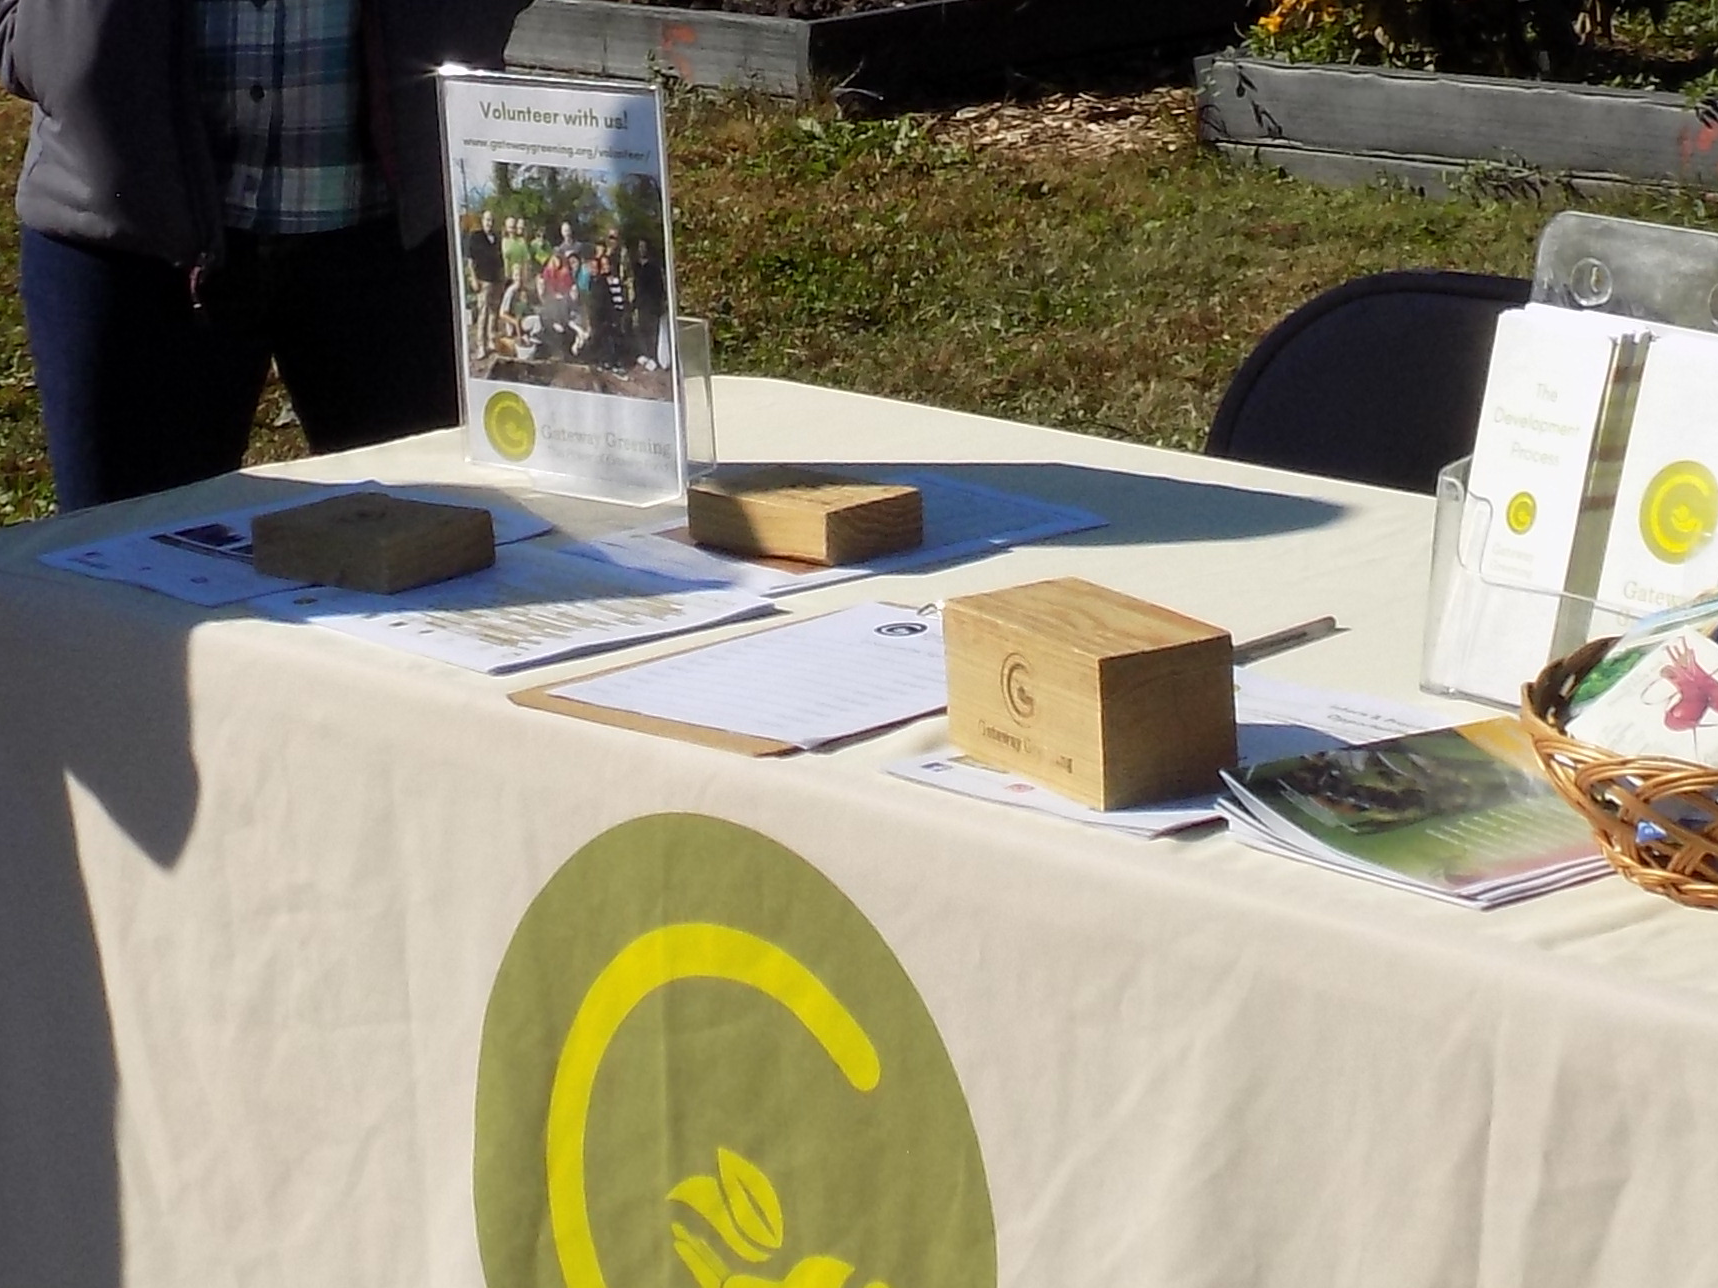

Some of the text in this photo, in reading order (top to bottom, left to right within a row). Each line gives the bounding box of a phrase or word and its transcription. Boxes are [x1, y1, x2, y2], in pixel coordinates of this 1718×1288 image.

[479, 101, 628, 130] Volunteer with us!
[463, 137, 652, 162] www.gatewaygreening.org/volunteer/
[1535, 383, 1558, 403] The
[1493, 406, 1581, 437] Development
[541, 424, 599, 450] Gateway
[605, 432, 671, 459] Greening
[1511, 442, 1561, 467] Process
